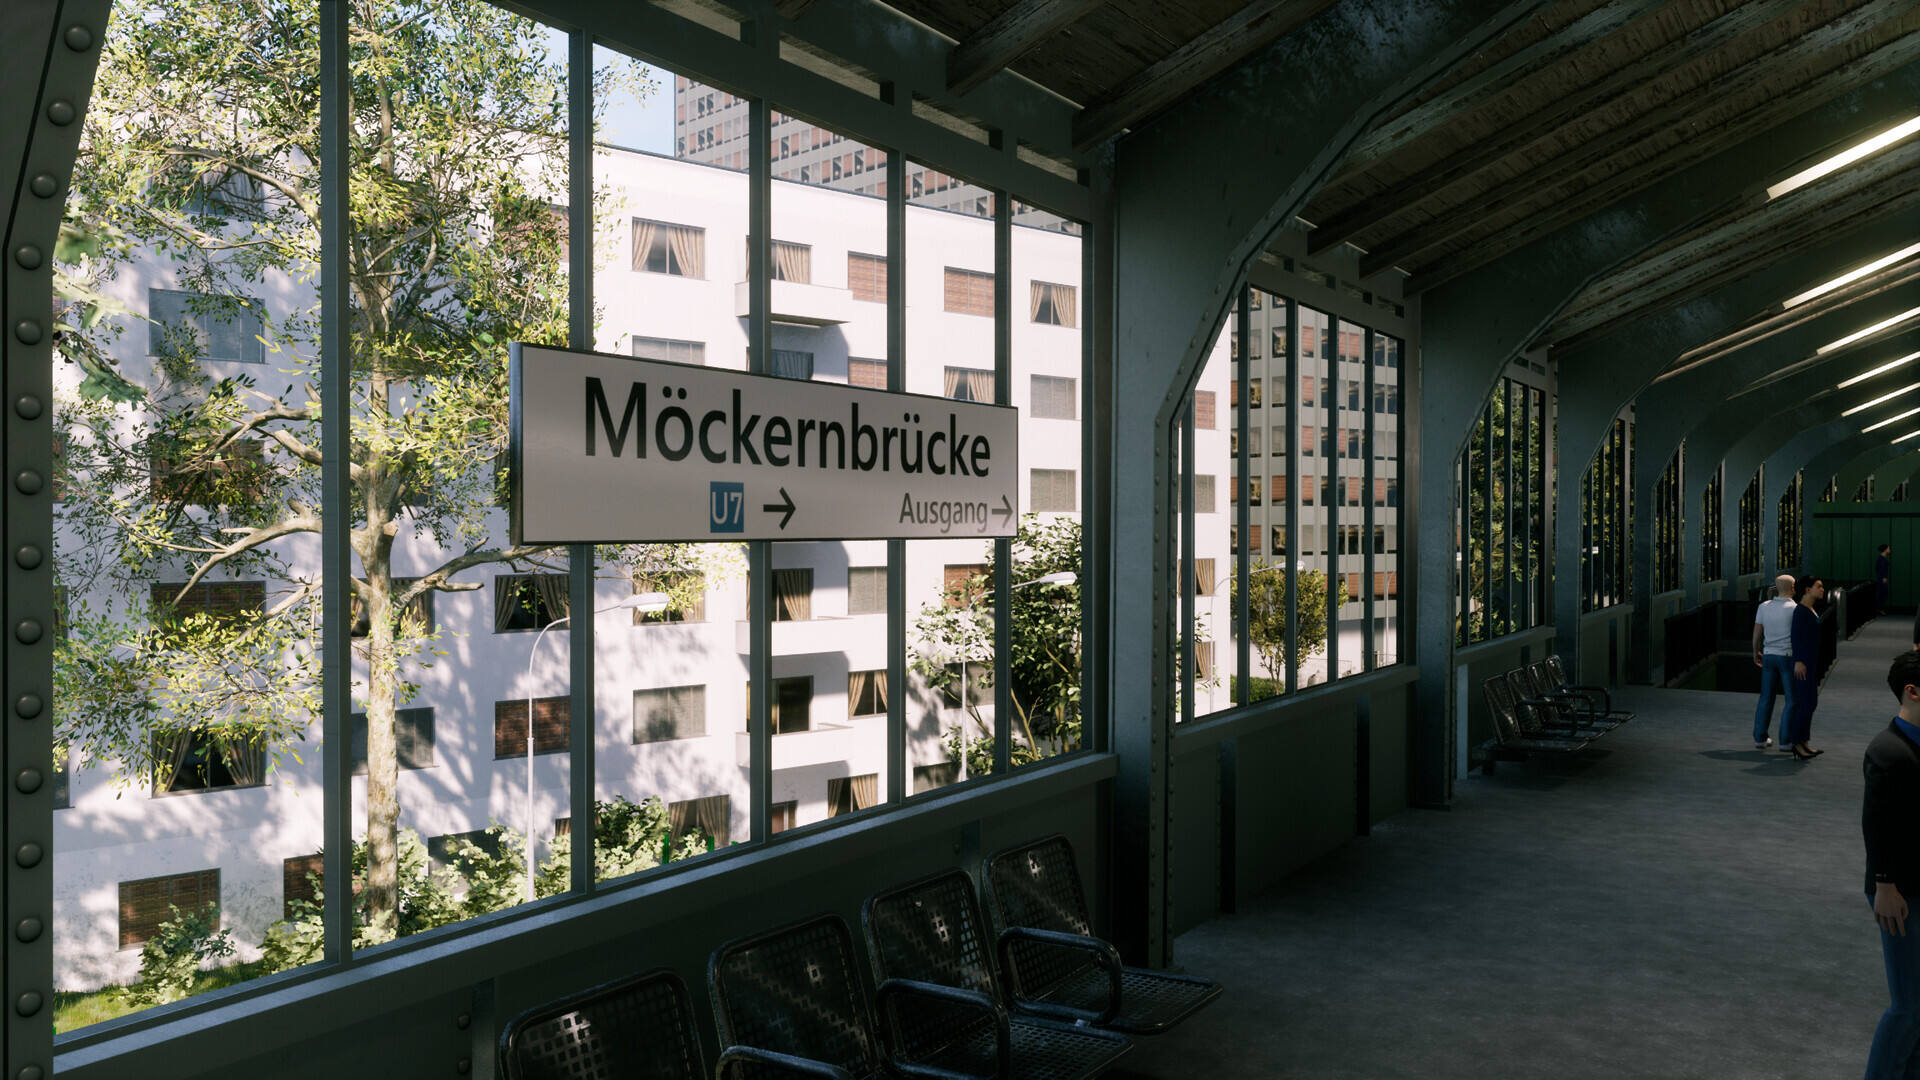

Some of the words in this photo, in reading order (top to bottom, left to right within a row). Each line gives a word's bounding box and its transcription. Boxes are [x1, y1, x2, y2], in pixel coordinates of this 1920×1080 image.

[585, 376, 991, 477] Möckernbrücke
[711, 491, 743, 524] U7
[899, 492, 988, 534] Ausgang
